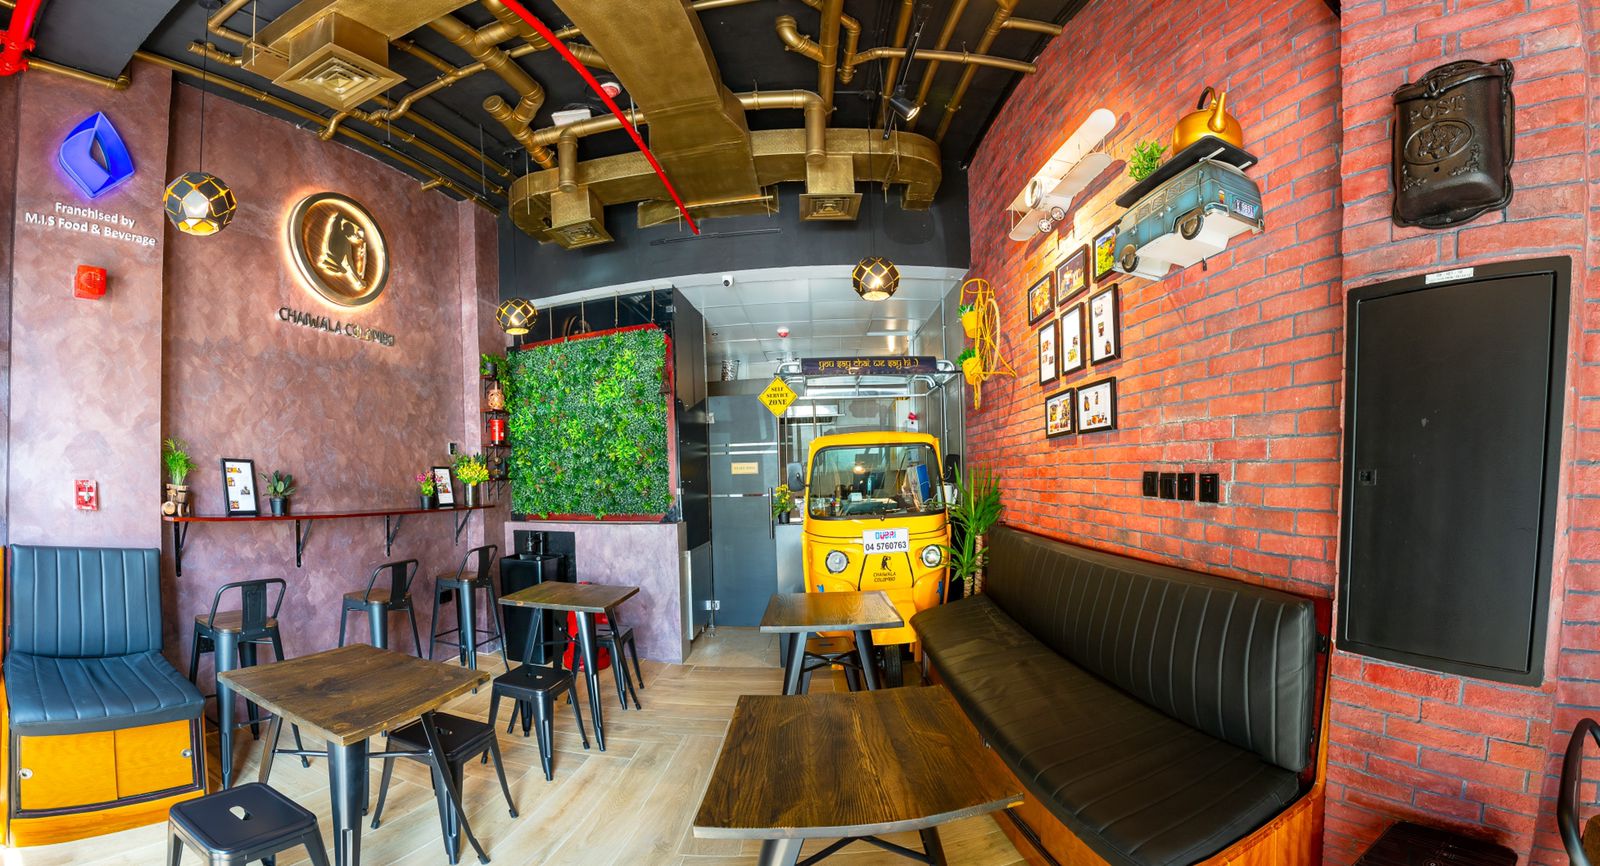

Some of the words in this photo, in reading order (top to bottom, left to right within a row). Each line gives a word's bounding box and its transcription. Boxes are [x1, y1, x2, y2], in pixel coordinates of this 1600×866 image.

[1409, 94, 1466, 125] POST
[55, 202, 119, 224] Franchised
[121, 214, 136, 228] by
[25, 212, 56, 226] M.I.S
[58, 217, 88, 233] Food
[91, 224, 101, 235] &
[103, 226, 156, 246] Beverage
[278, 307, 342, 334] CHAIWALA
[818, 359, 834, 370] you
[837, 359, 852, 369] say
[873, 359, 885, 367] we
[888, 359, 902, 369] say
[865, 543, 874, 551] 04
[876, 540, 907, 551] 5760763
